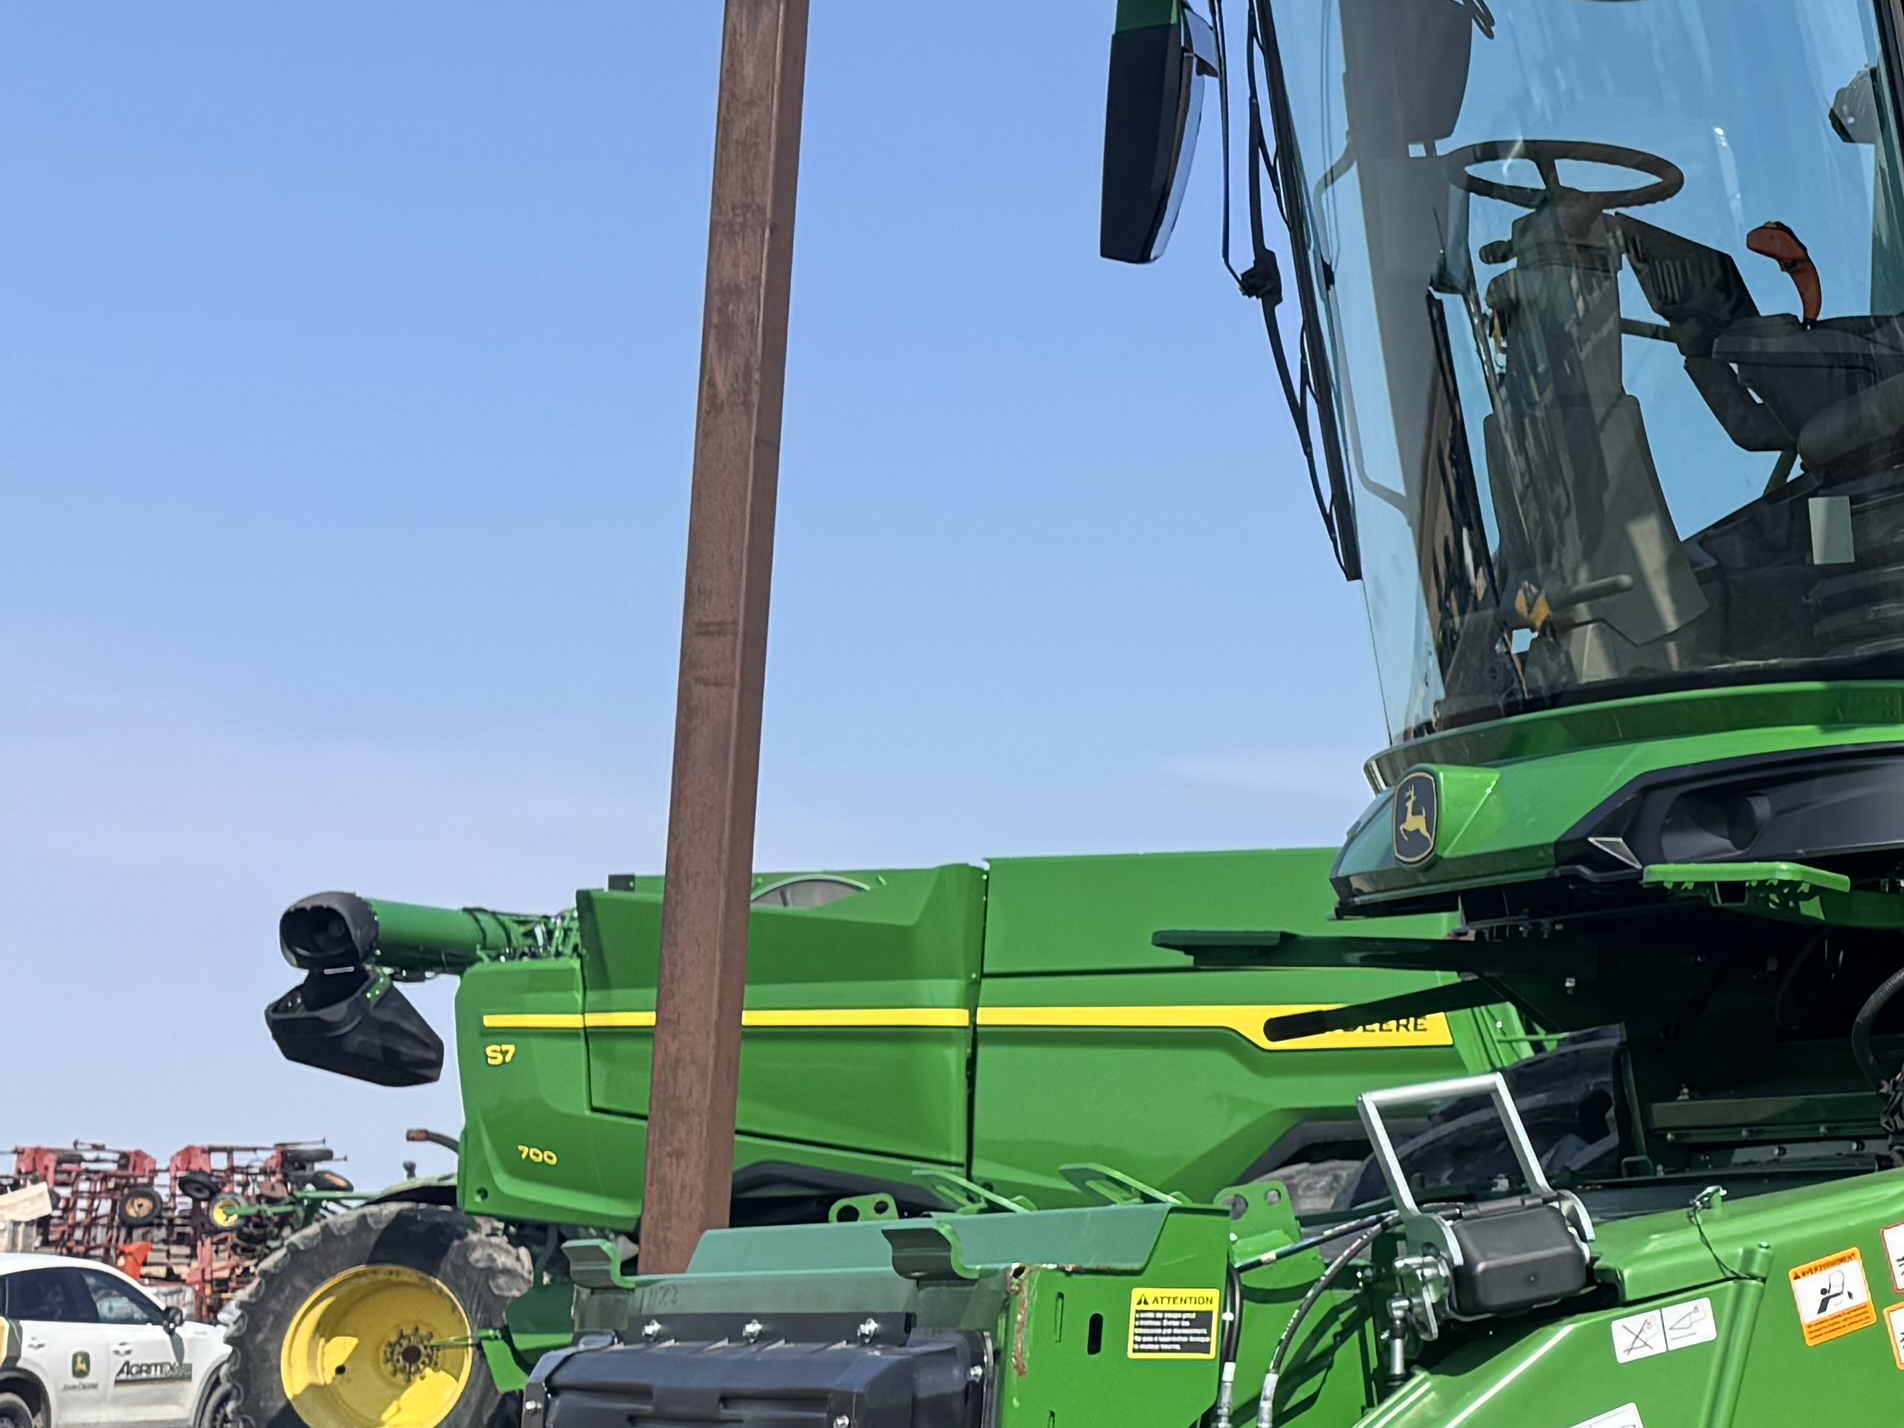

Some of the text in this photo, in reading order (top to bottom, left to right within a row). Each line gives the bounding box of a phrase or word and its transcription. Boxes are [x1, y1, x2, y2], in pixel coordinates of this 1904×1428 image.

[485, 1044, 516, 1066] S7
[517, 1145, 558, 1166] 700
[1152, 1296, 1213, 1305] ATTENTION
